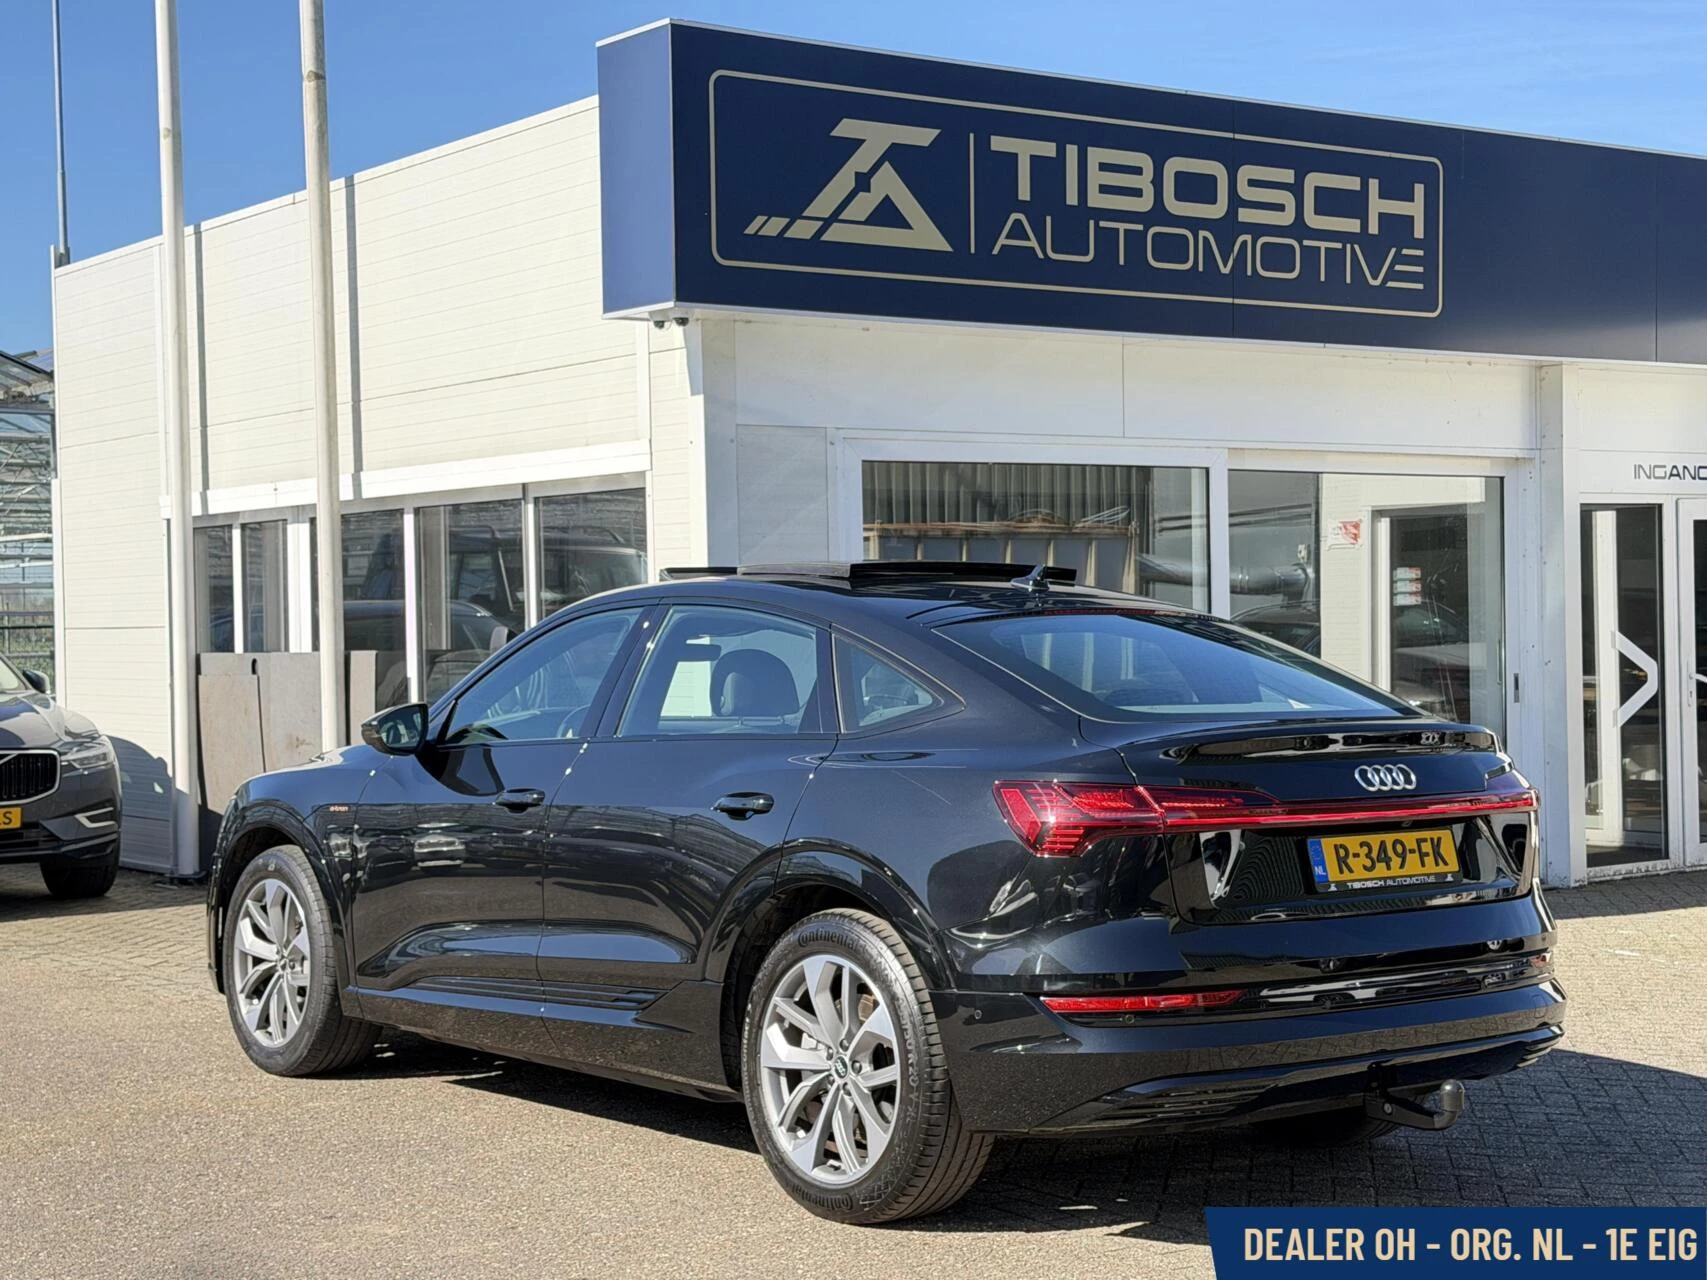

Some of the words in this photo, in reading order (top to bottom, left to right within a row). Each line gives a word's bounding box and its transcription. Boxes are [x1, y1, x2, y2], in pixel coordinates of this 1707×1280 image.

[990, 135, 1425, 240] TIBOSCH
[991, 212, 1425, 291] AUTOMOTIVE
[1314, 866, 1327, 876] NL
[1333, 836, 1449, 875] R-349-FK
[1346, 877, 1384, 889] TIBOSCH
[1386, 875, 1437, 887] AUTOMOTIVE
[797, 927, 860, 952] Continental
